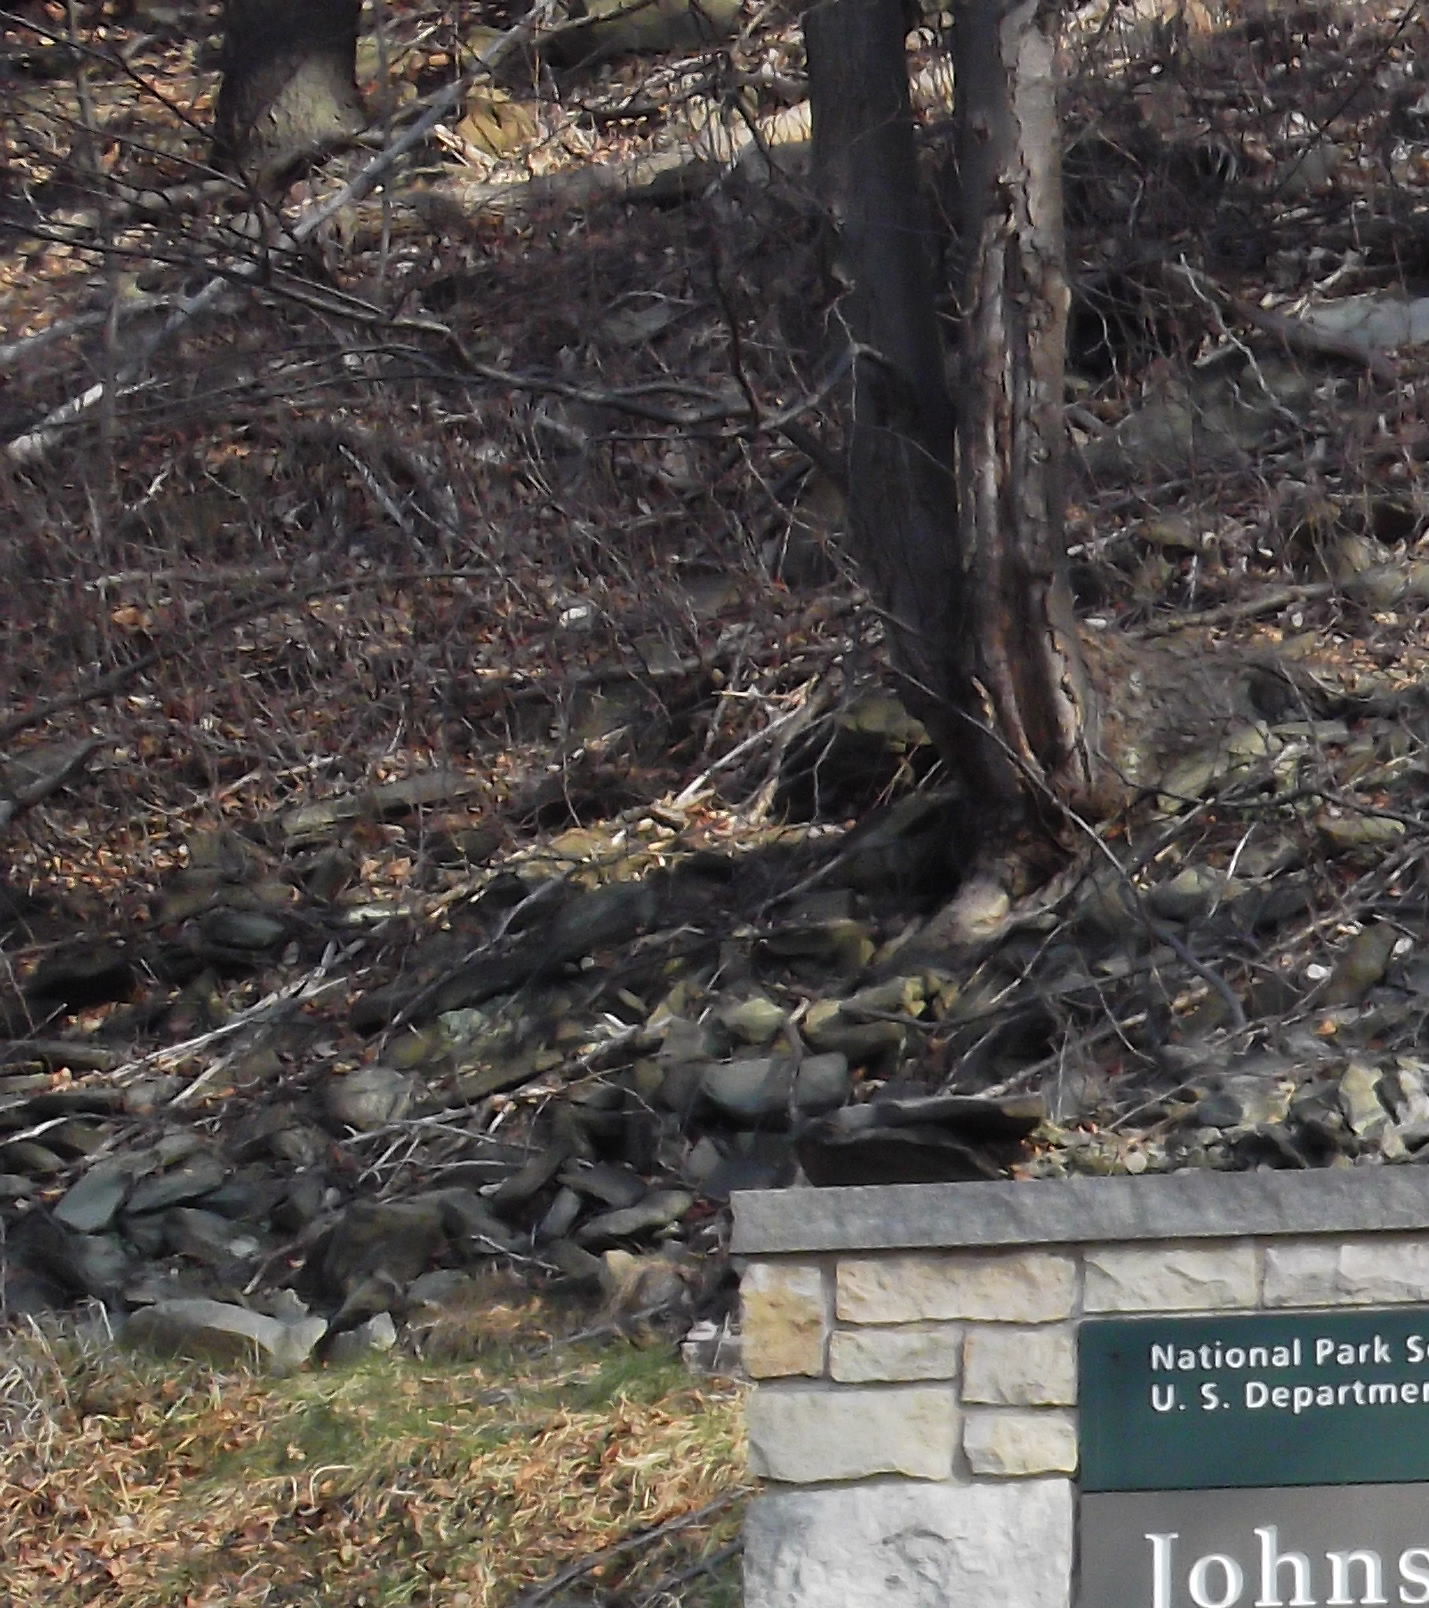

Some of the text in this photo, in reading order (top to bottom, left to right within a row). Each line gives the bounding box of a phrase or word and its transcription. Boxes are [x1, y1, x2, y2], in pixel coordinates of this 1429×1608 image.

[1151, 1336, 1300, 1370] National
[1315, 1335, 1391, 1366] Park
[1151, 1383, 1186, 1412] U.
[1200, 1382, 1230, 1410] S.
